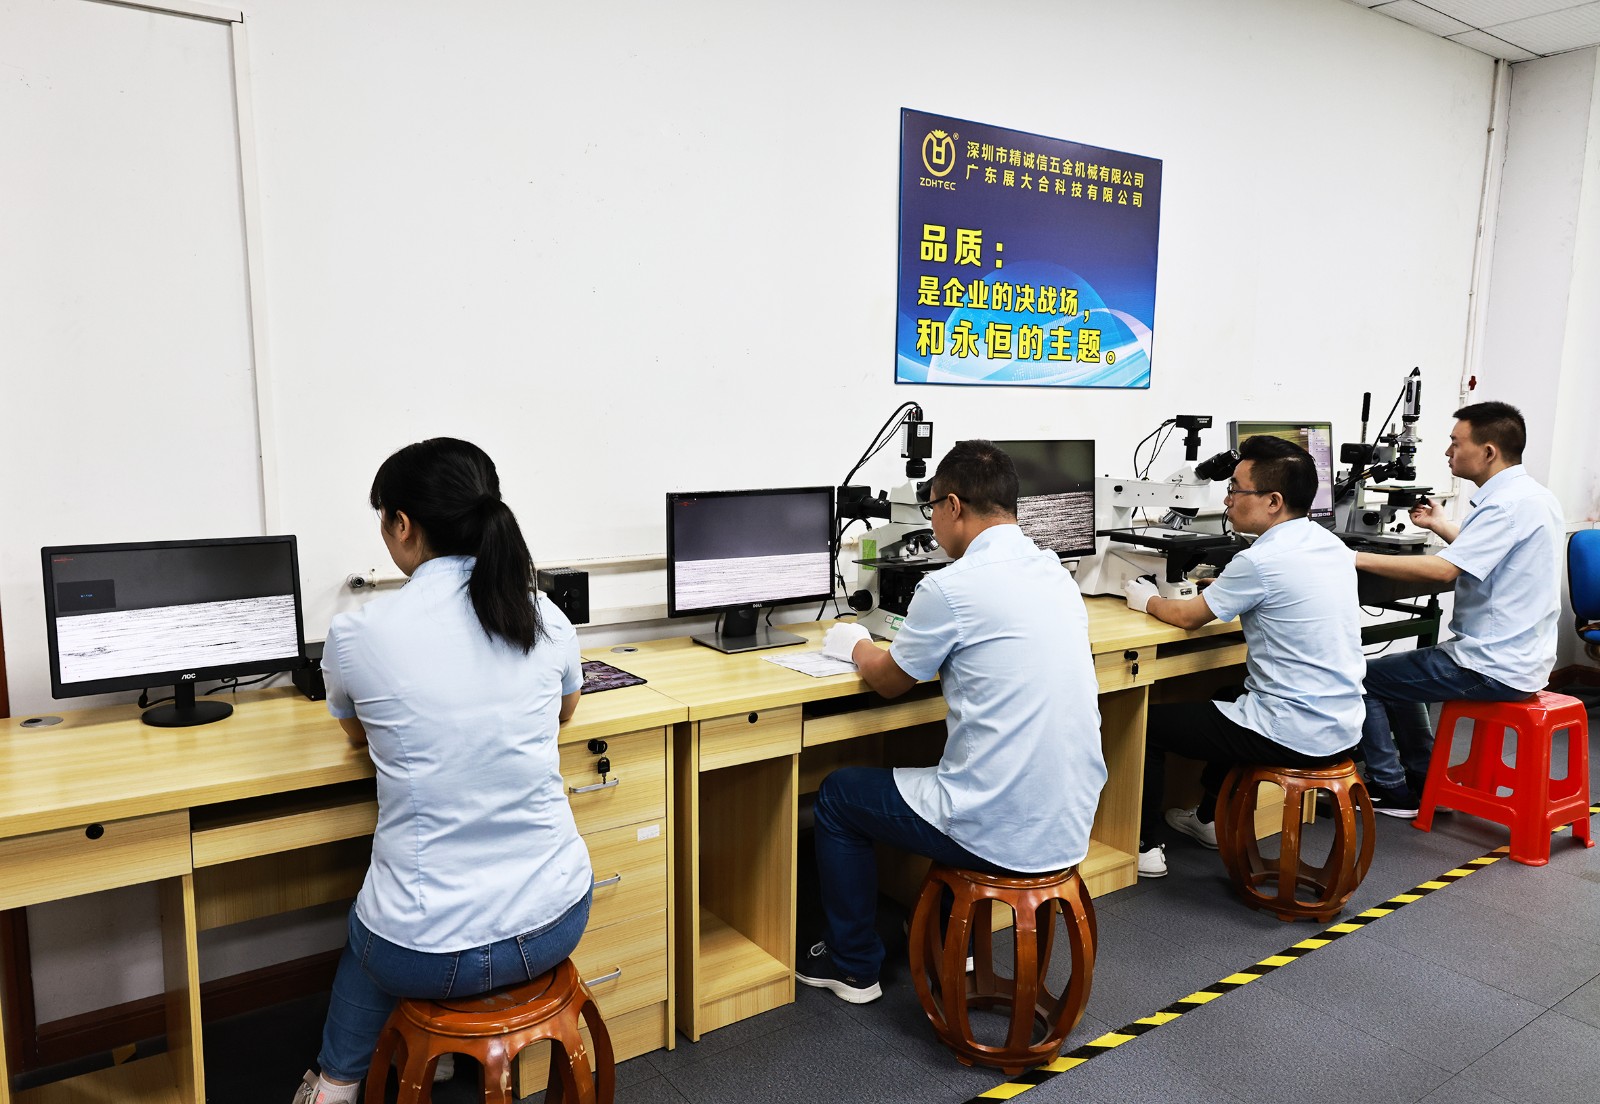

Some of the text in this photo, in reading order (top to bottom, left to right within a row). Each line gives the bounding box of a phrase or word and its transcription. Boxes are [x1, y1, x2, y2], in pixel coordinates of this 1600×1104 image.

[919, 177, 957, 191] ZDHTEC
[965, 163, 1143, 208] 广东展大合科技有限公司
[966, 141, 1145, 188] 深圳市精诚信五金机械有限公司
[917, 275, 1091, 323] 是企业的决战场，
[915, 318, 1116, 365] 和永恒的主题。
[181, 672, 197, 680] AOC
